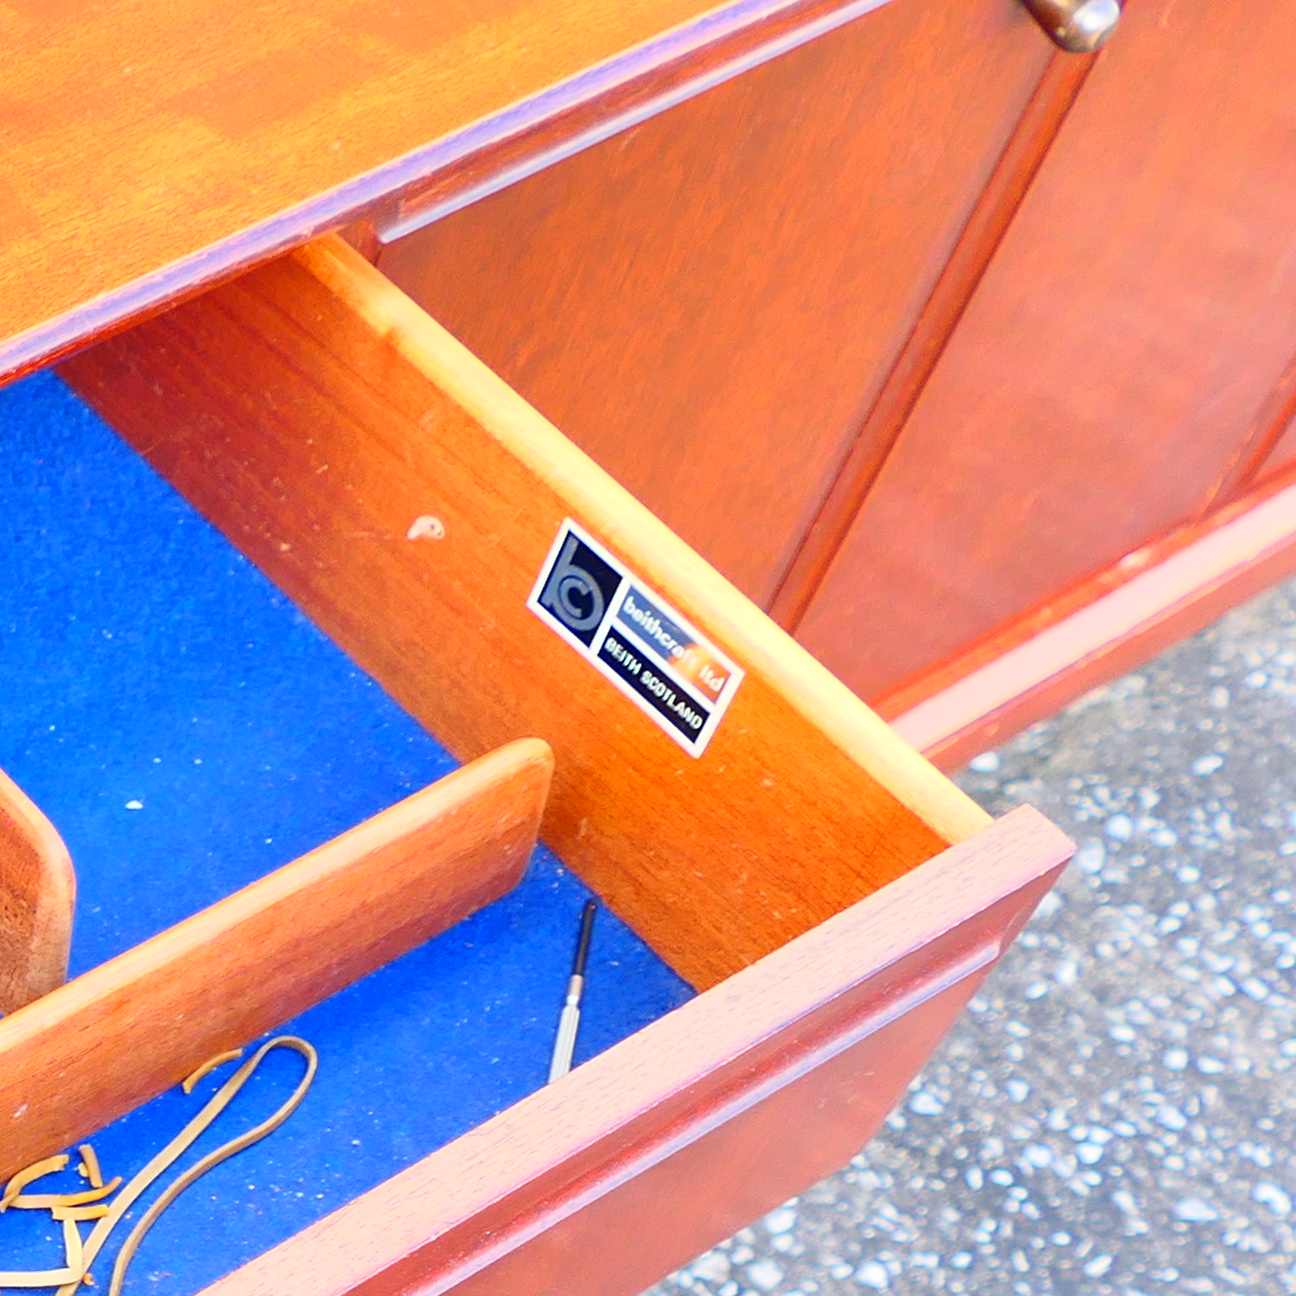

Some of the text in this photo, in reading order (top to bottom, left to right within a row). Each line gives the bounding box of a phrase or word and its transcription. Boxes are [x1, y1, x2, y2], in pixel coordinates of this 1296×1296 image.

[604, 637, 703, 730] BEITH SCOTLAND
[698, 664, 725, 692] ltd
